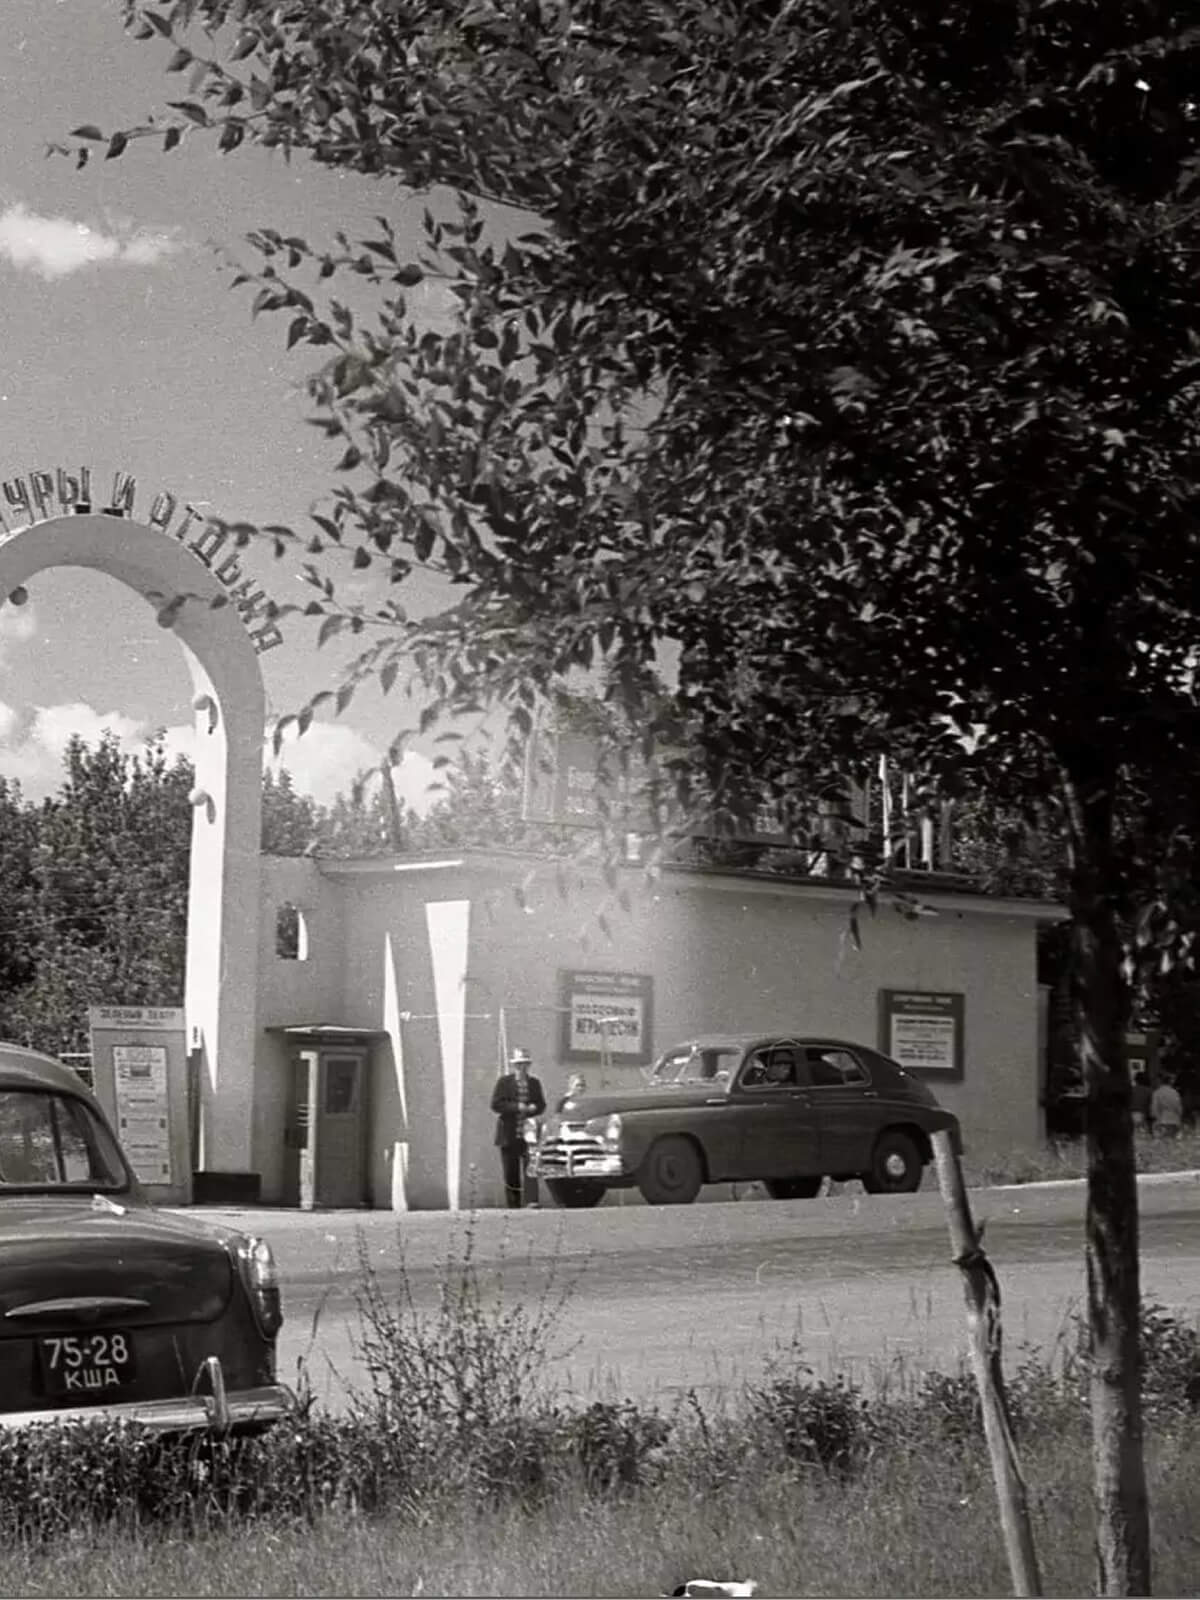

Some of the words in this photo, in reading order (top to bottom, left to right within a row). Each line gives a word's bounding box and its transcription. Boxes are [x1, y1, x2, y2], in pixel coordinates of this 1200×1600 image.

[111, 471, 137, 521] И
[43, 1334, 129, 1370] 75-28
[63, 1366, 121, 1390] КША
